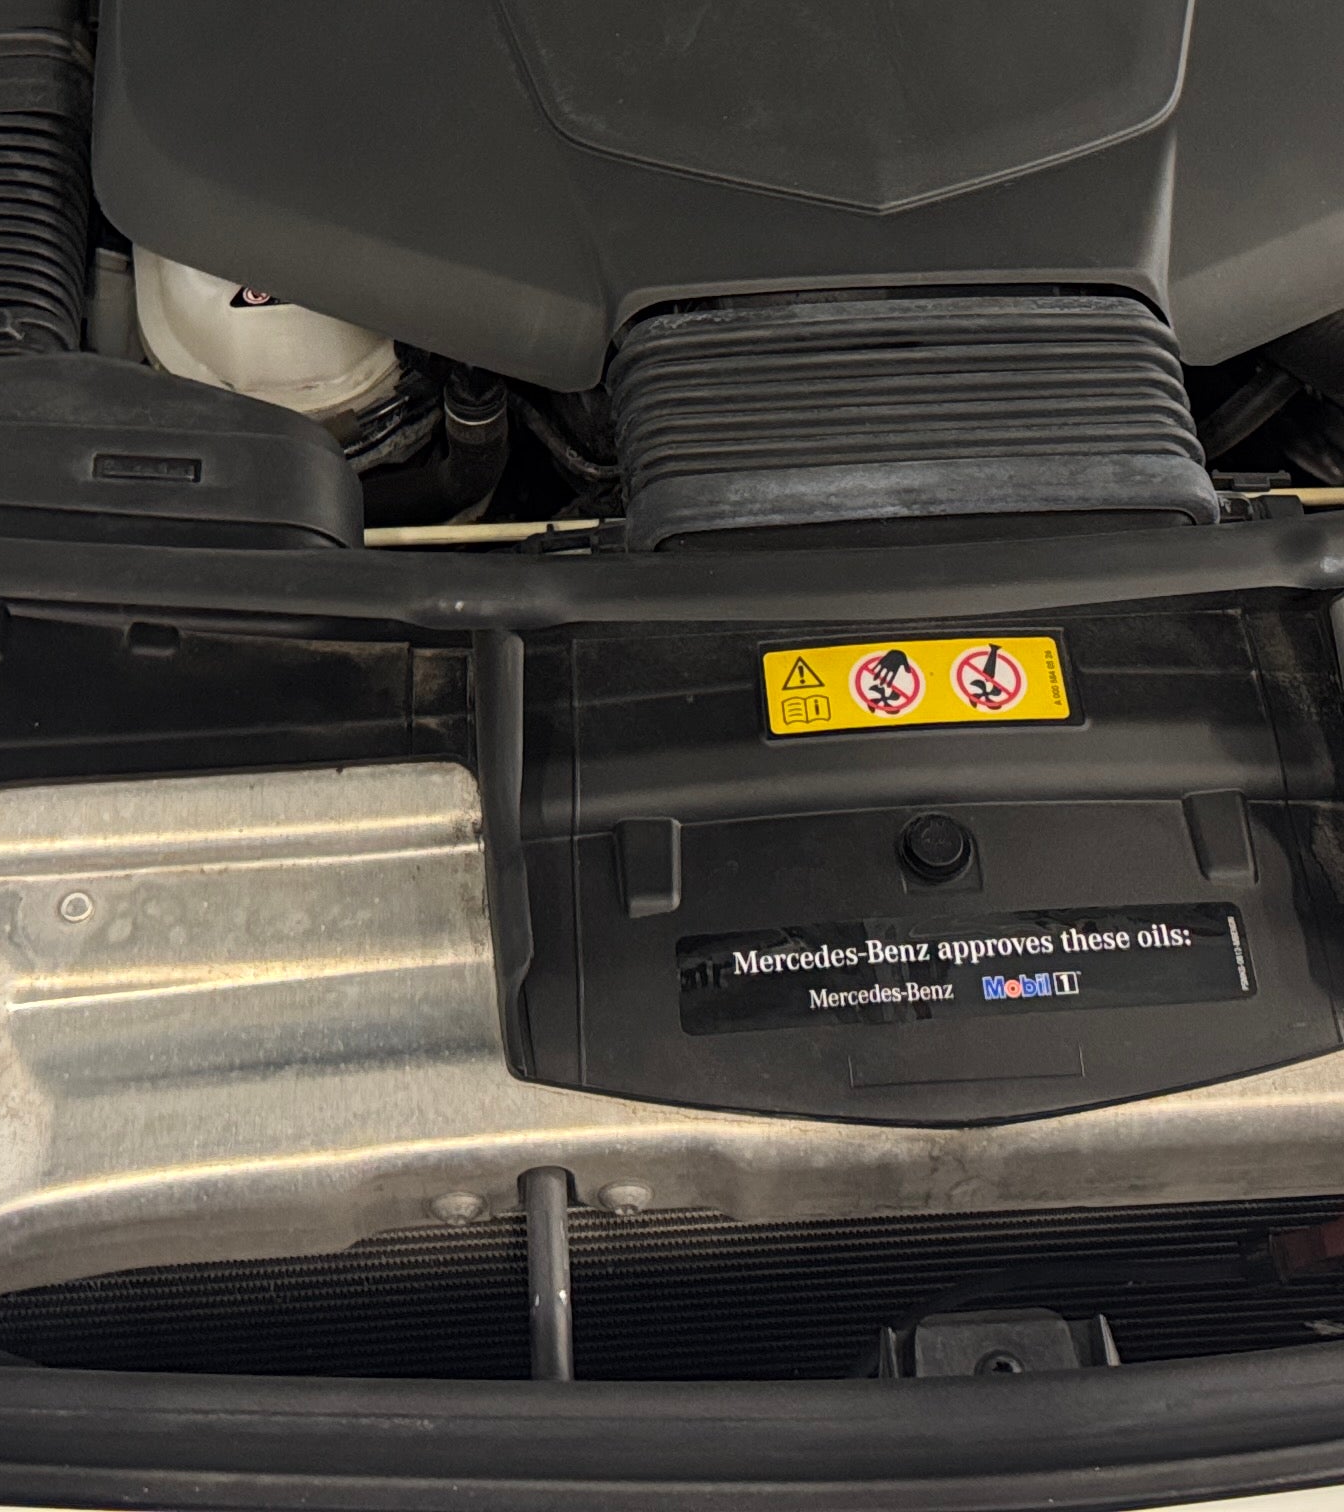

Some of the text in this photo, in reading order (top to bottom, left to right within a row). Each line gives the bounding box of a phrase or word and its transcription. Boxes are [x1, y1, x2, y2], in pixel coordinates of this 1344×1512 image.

[733, 923, 1193, 975] Mercedes-Benz approves these oils:
[808, 978, 954, 1010] Mercedes-Benz
[982, 973, 1052, 1000] Mobil
